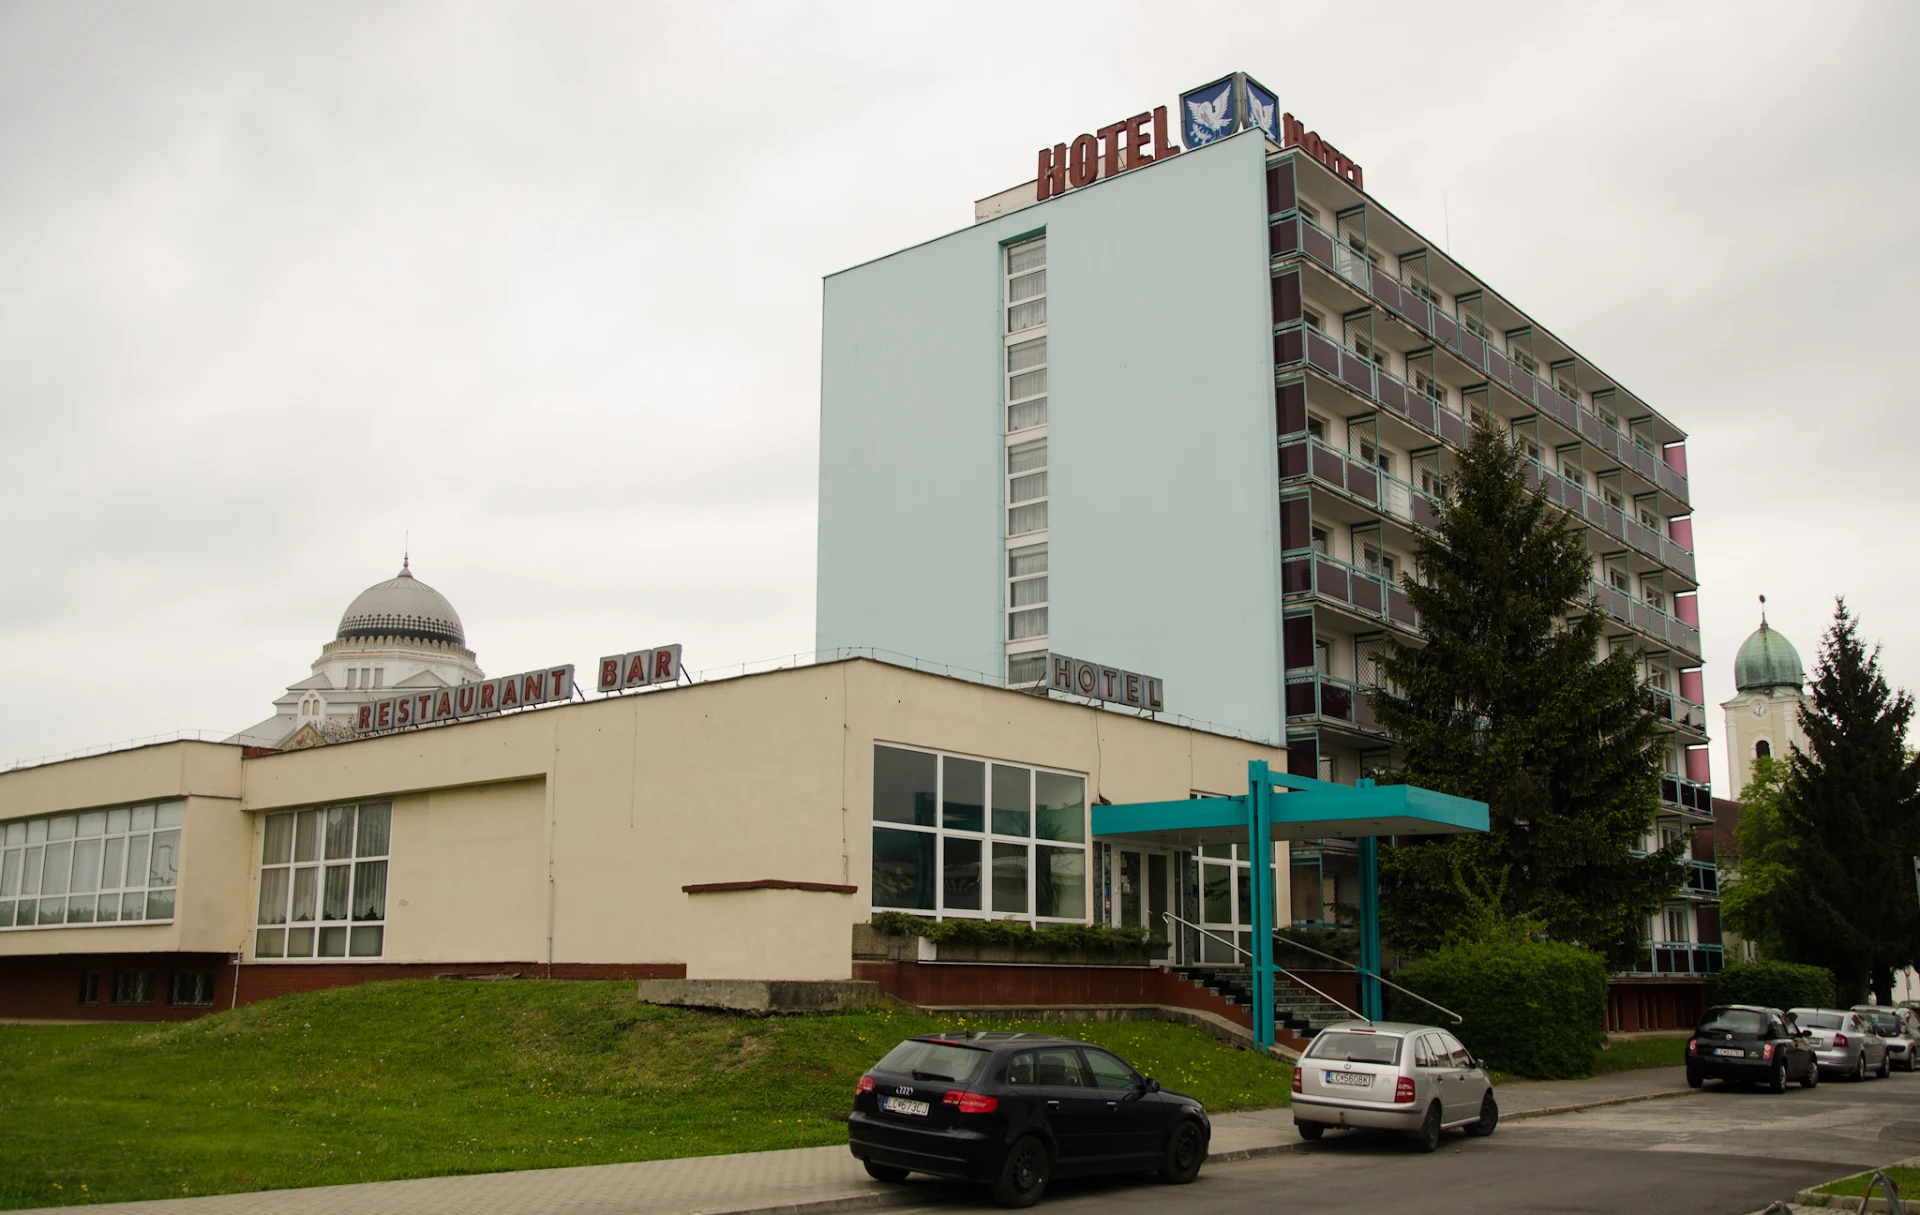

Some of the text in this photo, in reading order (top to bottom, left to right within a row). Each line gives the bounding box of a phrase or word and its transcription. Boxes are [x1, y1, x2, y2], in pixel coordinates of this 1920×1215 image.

[1037, 105, 1180, 201] HOTEL
[358, 651, 672, 729] RESTAURANT BAR
[1055, 658, 1161, 706] HOTEL
